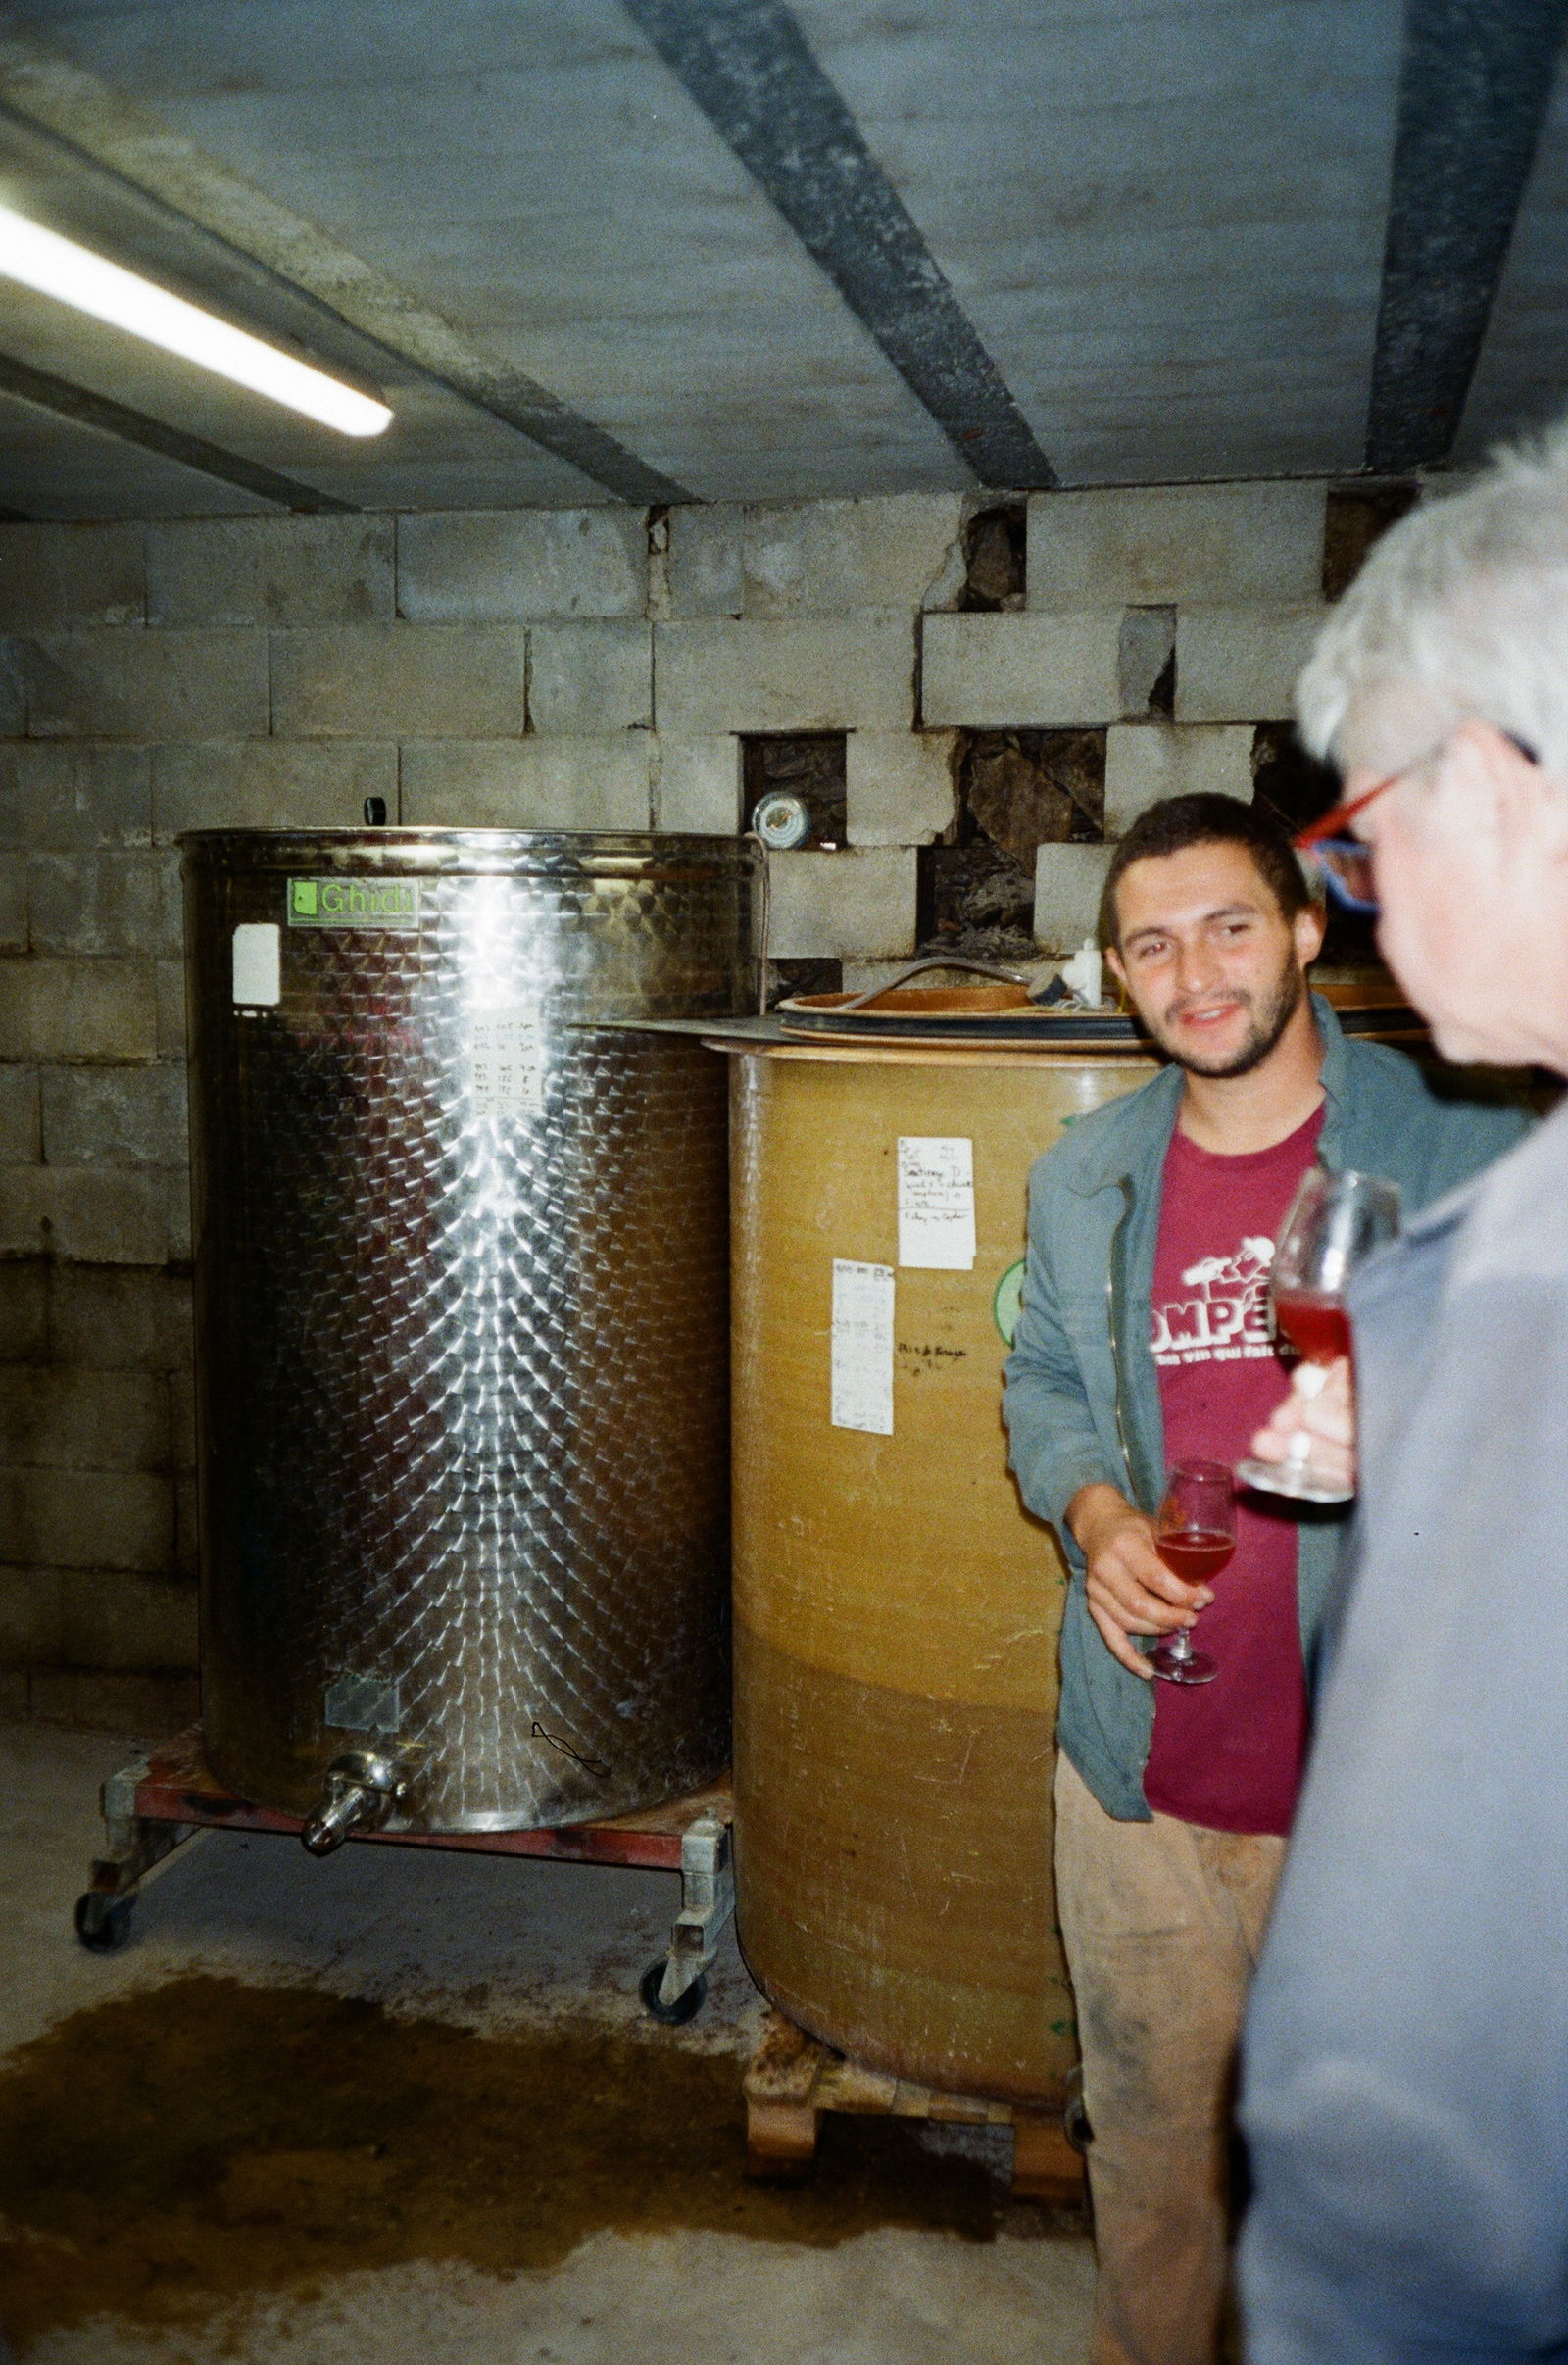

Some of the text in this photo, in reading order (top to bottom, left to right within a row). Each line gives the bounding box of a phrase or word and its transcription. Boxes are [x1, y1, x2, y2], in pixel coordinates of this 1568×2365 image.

[321, 884, 412, 912] Ghidi
[1183, 1349, 1211, 1363] vin
[1213, 1346, 1242, 1361] qui
[1243, 1344, 1274, 1358] fait
